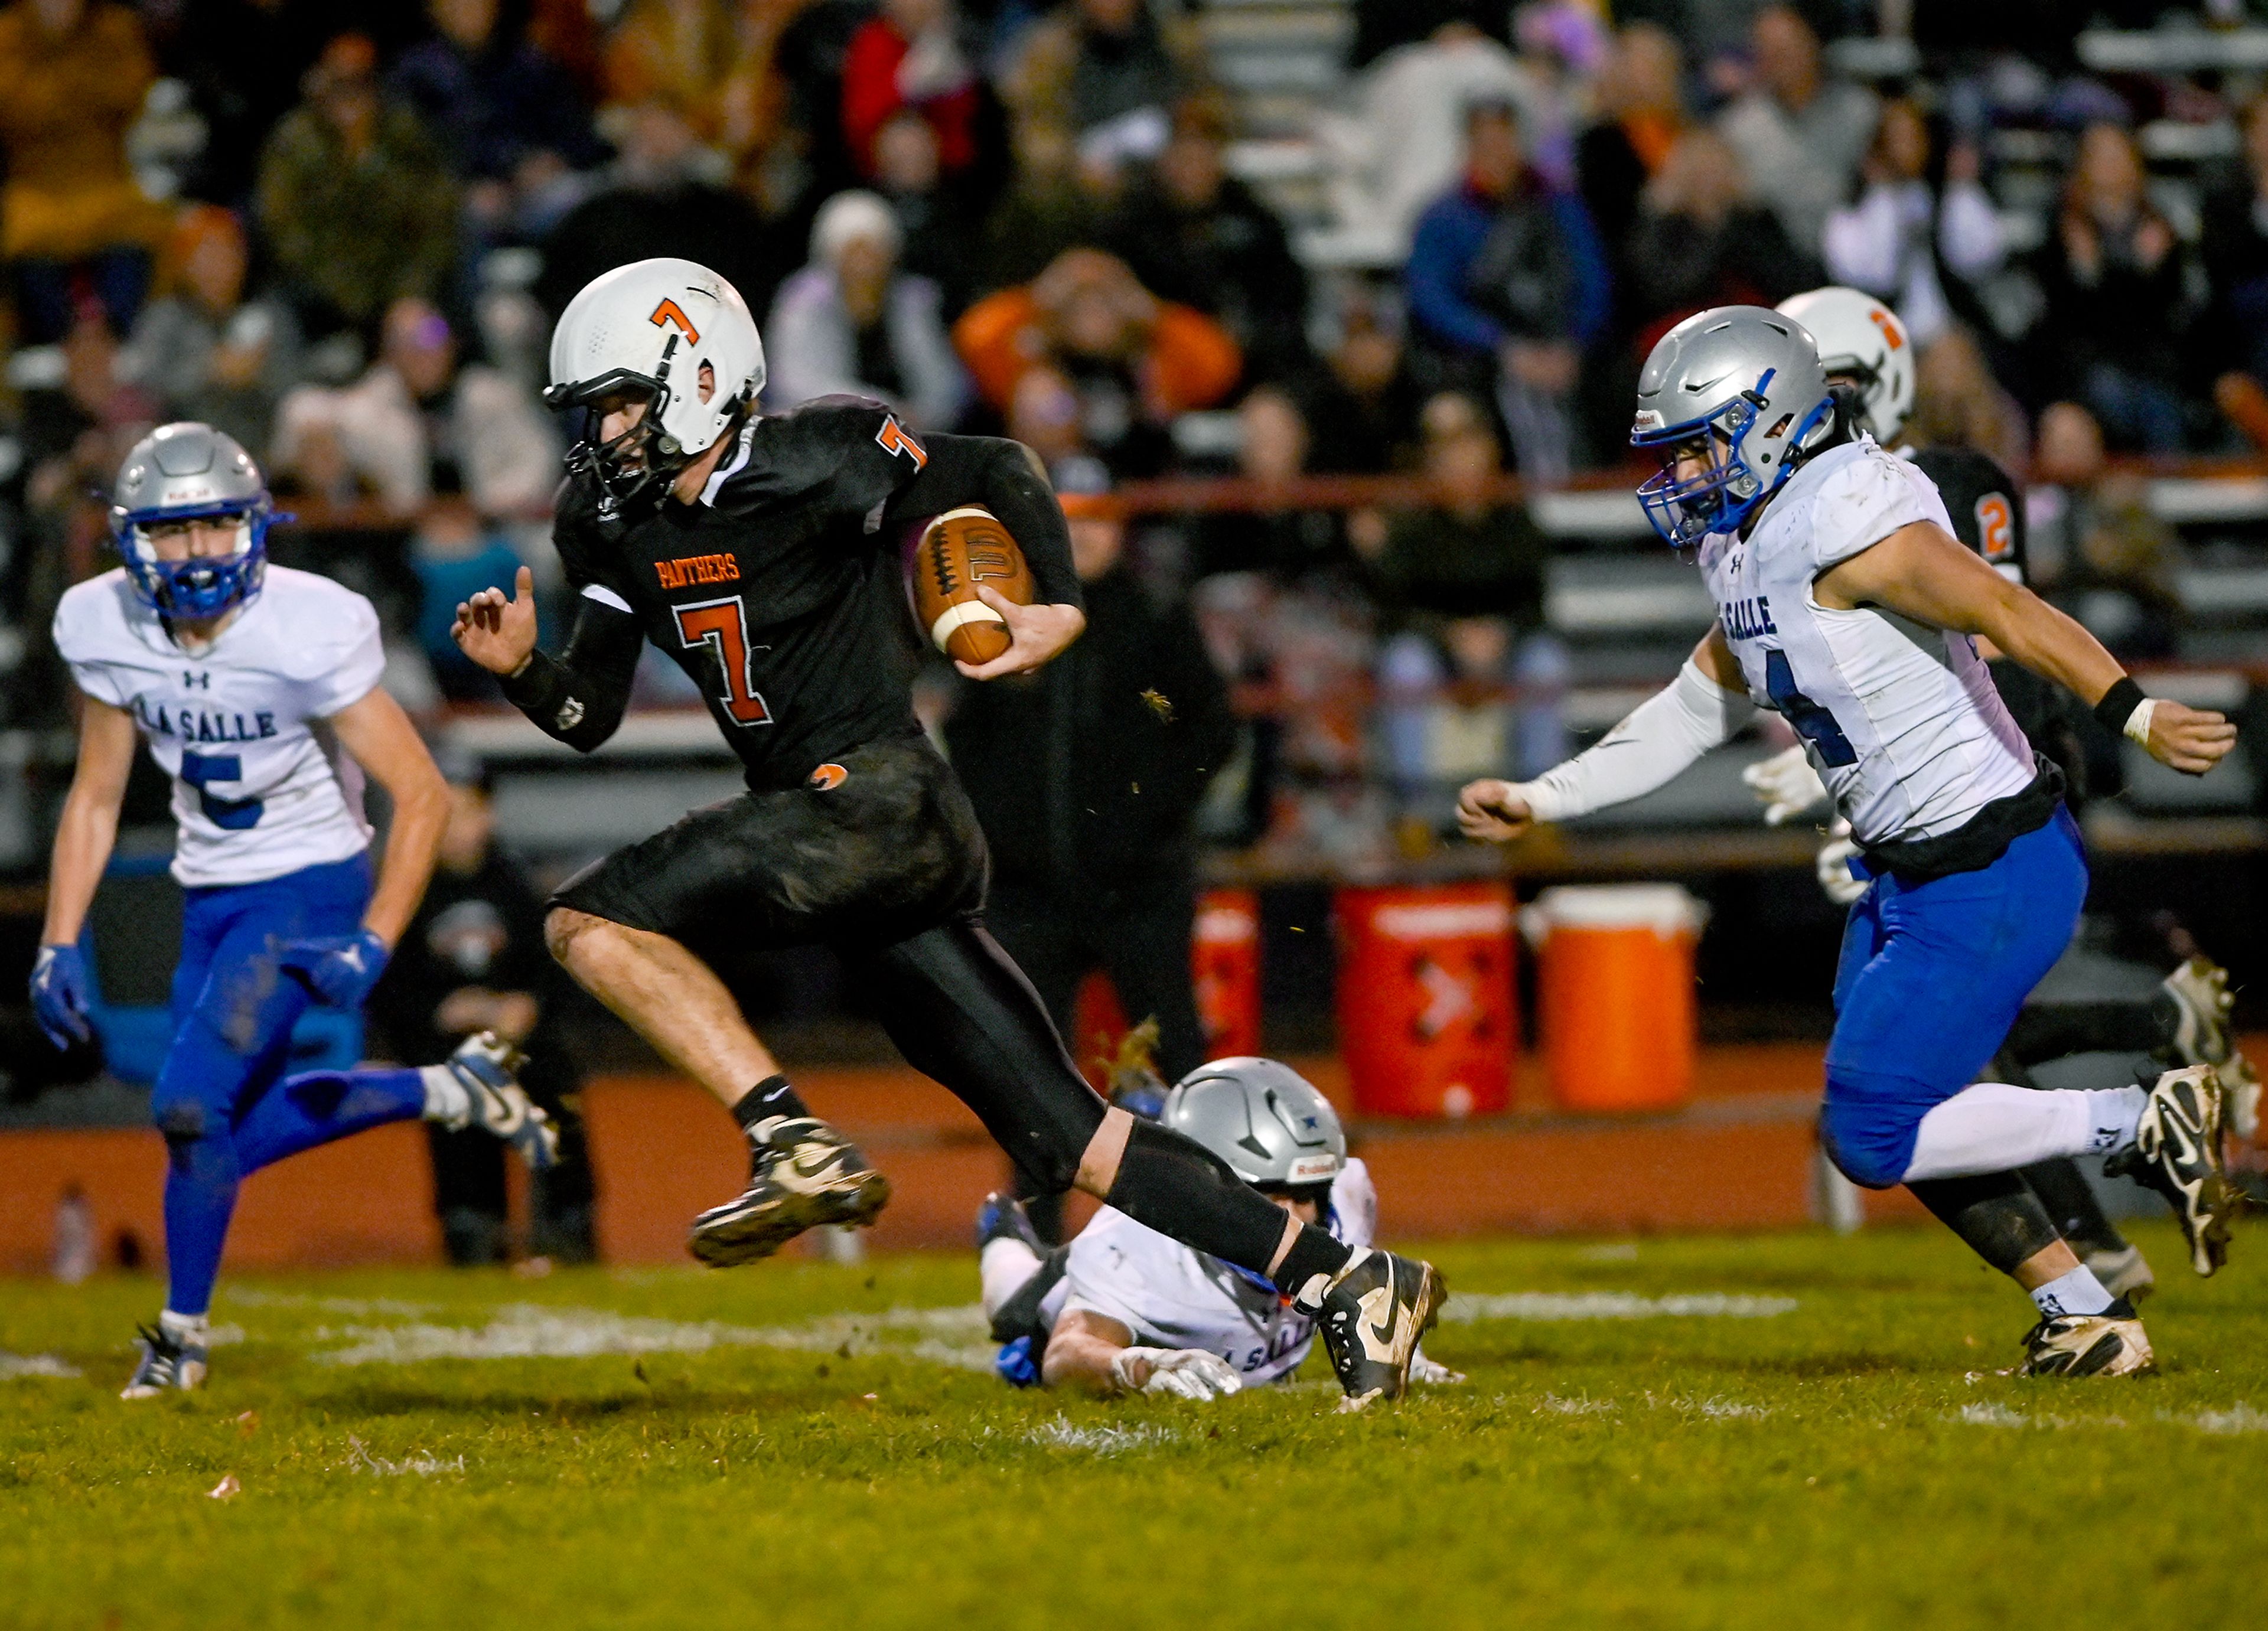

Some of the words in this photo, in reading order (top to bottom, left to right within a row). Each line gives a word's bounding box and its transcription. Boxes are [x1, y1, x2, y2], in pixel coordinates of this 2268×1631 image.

[649, 297, 700, 347] 7
[874, 413, 928, 475] 7
[1974, 491, 2015, 561] 2
[655, 553, 741, 589] PANTHERS
[1725, 595, 1778, 640] SALLE
[671, 595, 774, 727] 7
[180, 710, 278, 742] SALLE
[180, 749, 265, 831] 5
